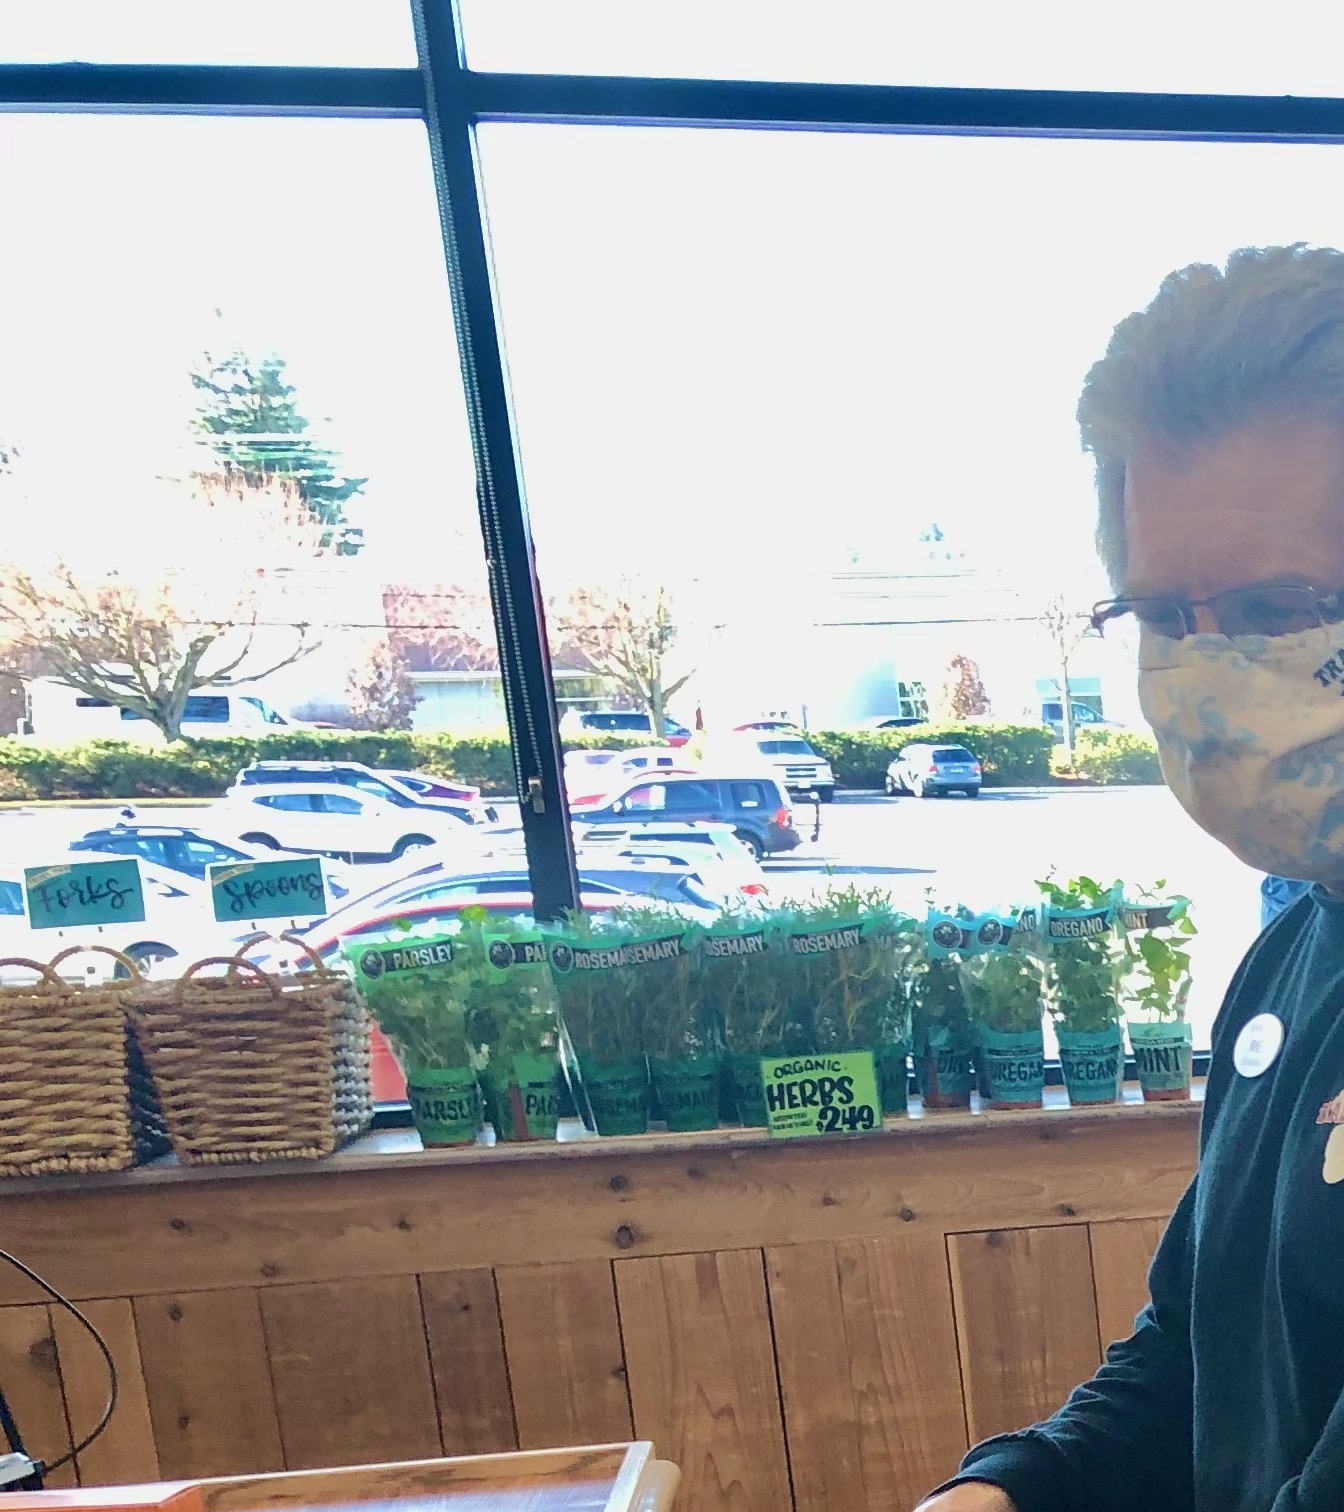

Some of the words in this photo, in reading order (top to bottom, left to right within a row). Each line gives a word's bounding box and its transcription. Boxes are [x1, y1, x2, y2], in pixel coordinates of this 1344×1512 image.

[33, 875, 135, 913] Forks
[222, 872, 323, 914] Spoons
[1051, 916, 1104, 938] OREGANO
[793, 930, 862, 955] ROSEMARY
[393, 943, 452, 970] PARSLEY
[773, 1058, 842, 1080] ORGANIC
[766, 1075, 854, 1112] HERBS
